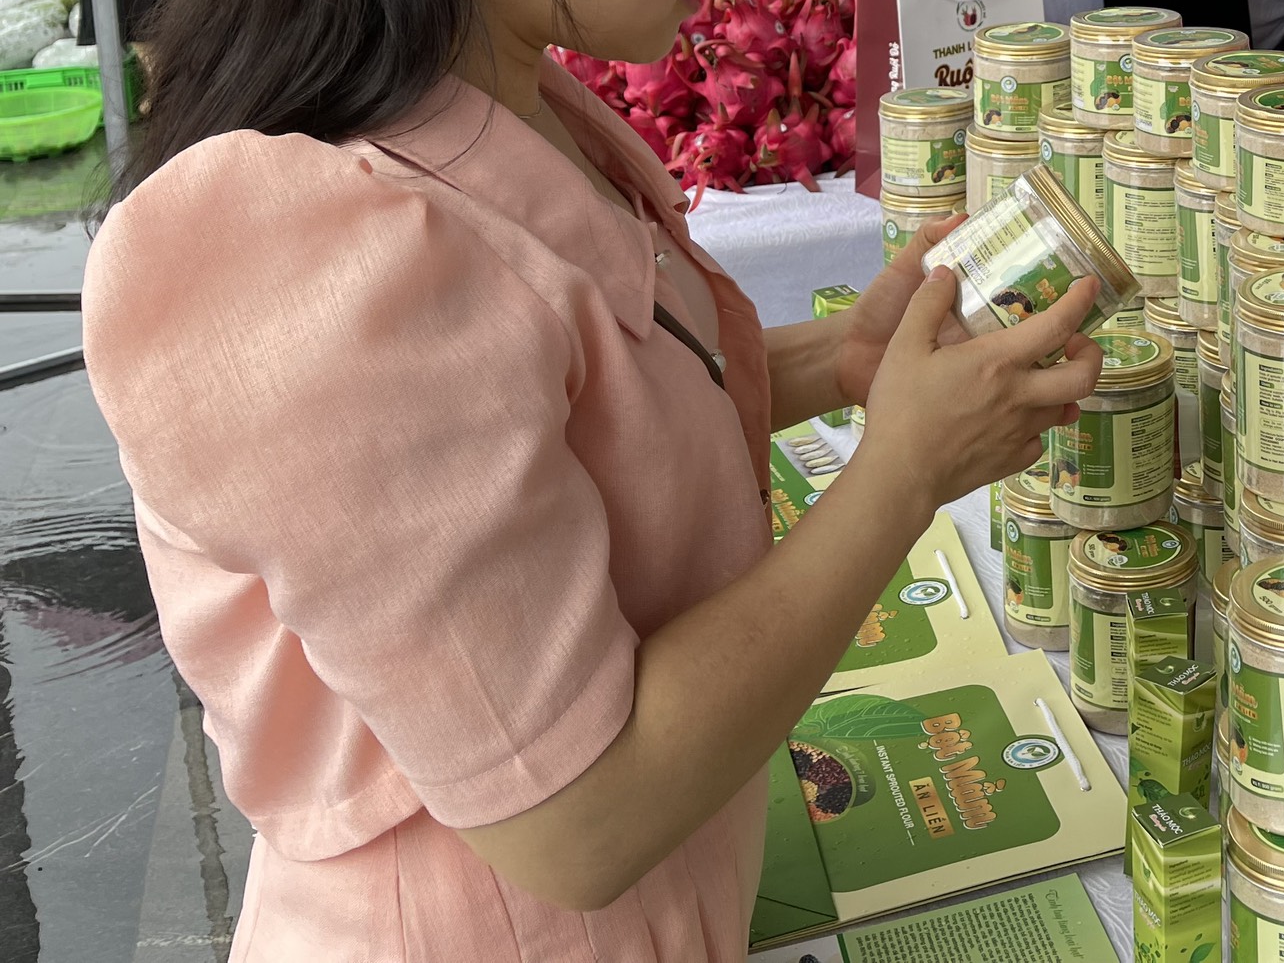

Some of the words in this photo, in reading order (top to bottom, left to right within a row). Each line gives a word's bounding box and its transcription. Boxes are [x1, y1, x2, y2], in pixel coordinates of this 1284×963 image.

[933, 43, 965, 59] THANH
[934, 58, 974, 89] Ruộ
[918, 712, 973, 762] Bột
[876, 745, 892, 774] INSTANT
[886, 773, 906, 809] SPROUTED
[900, 807, 915, 830] FLOUR
[912, 782, 927, 801] ĂN
[923, 805, 946, 836] LIỀN
[938, 755, 1006, 830] Mầm
